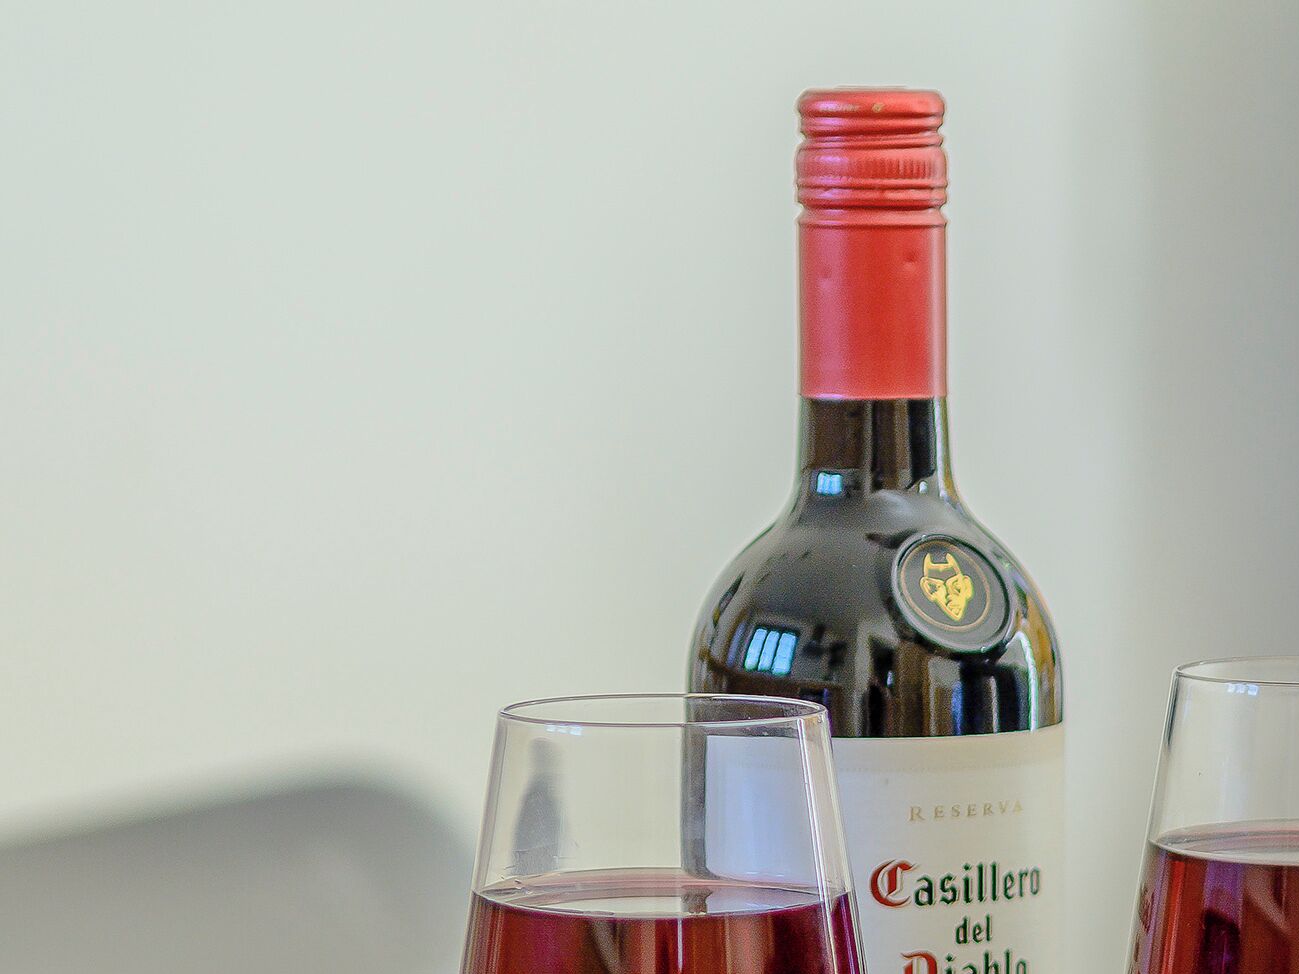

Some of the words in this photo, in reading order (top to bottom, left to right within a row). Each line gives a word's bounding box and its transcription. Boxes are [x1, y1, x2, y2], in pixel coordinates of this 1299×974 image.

[908, 799, 1024, 823] RESERVA
[868, 859, 1041, 908] Casillero
[955, 914, 993, 945] del
